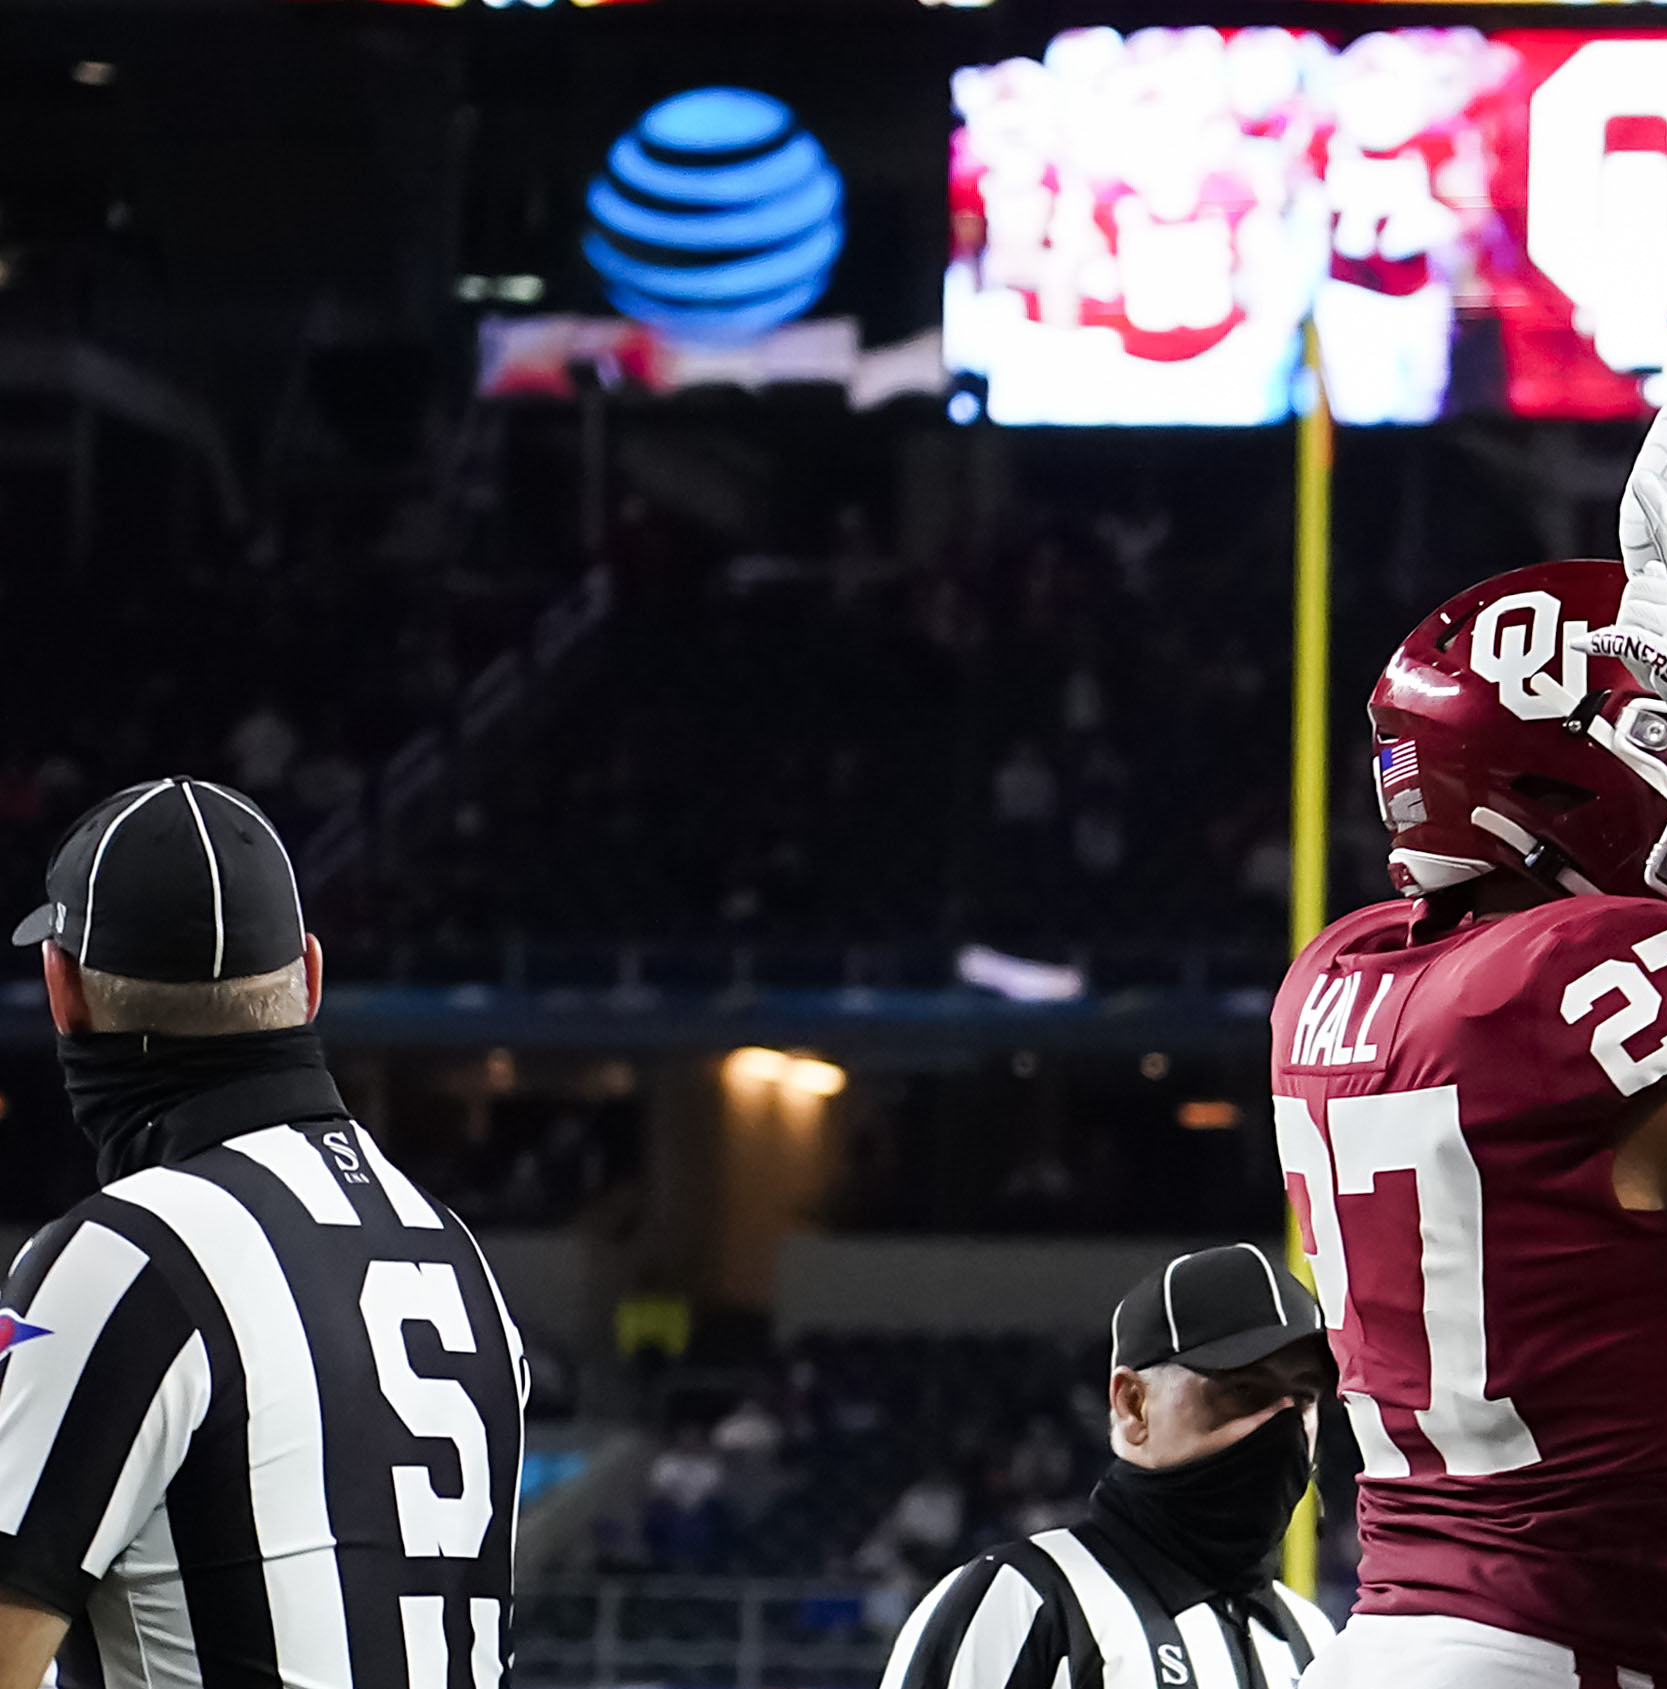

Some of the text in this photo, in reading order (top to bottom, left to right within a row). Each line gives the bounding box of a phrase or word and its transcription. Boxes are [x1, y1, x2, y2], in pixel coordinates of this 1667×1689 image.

[1470, 591, 1588, 720] OU
[1290, 971, 1395, 1067] HALL
[359, 1259, 493, 1558] S
